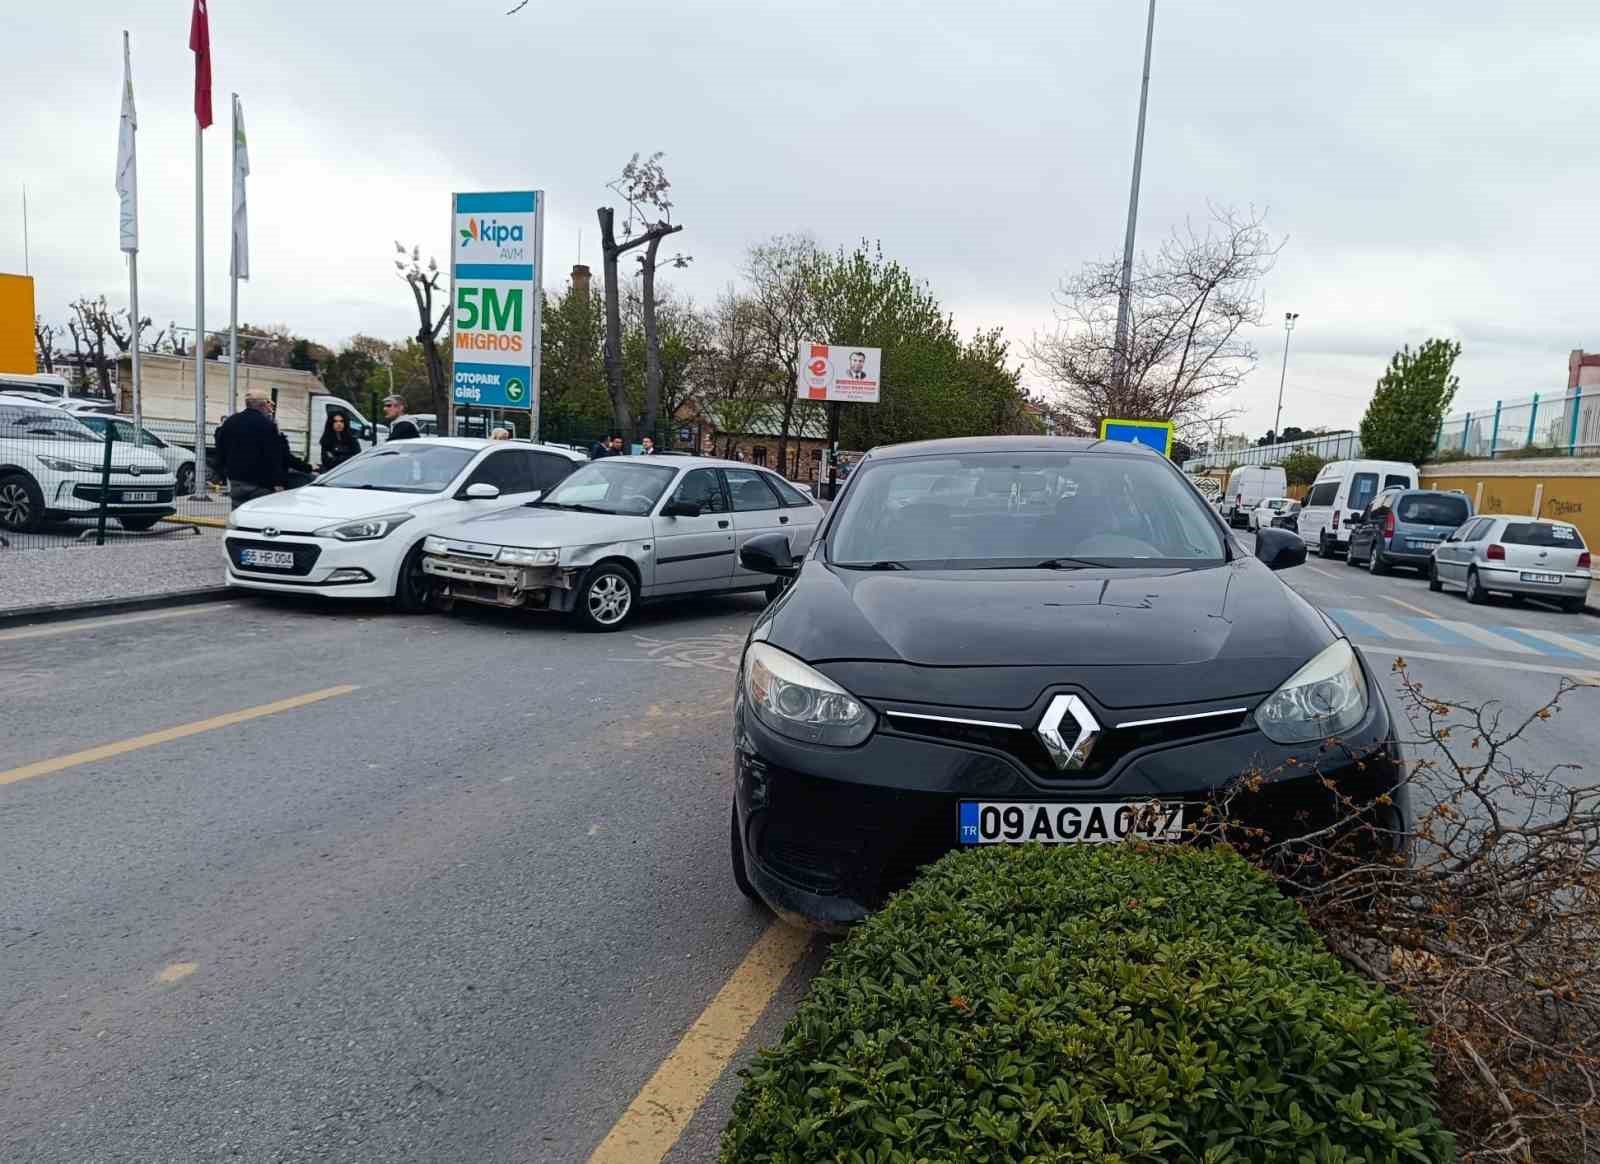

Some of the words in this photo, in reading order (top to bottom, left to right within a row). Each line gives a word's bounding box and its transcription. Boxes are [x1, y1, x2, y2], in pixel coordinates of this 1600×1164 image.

[481, 219, 523, 247] kipa
[500, 248, 523, 260] AVM
[457, 287, 523, 332] 5M
[455, 372, 500, 385] OTOPARK
[963, 826, 977, 836] TR
[980, 806, 1025, 840] 09
[1029, 806, 1109, 840] AGA
